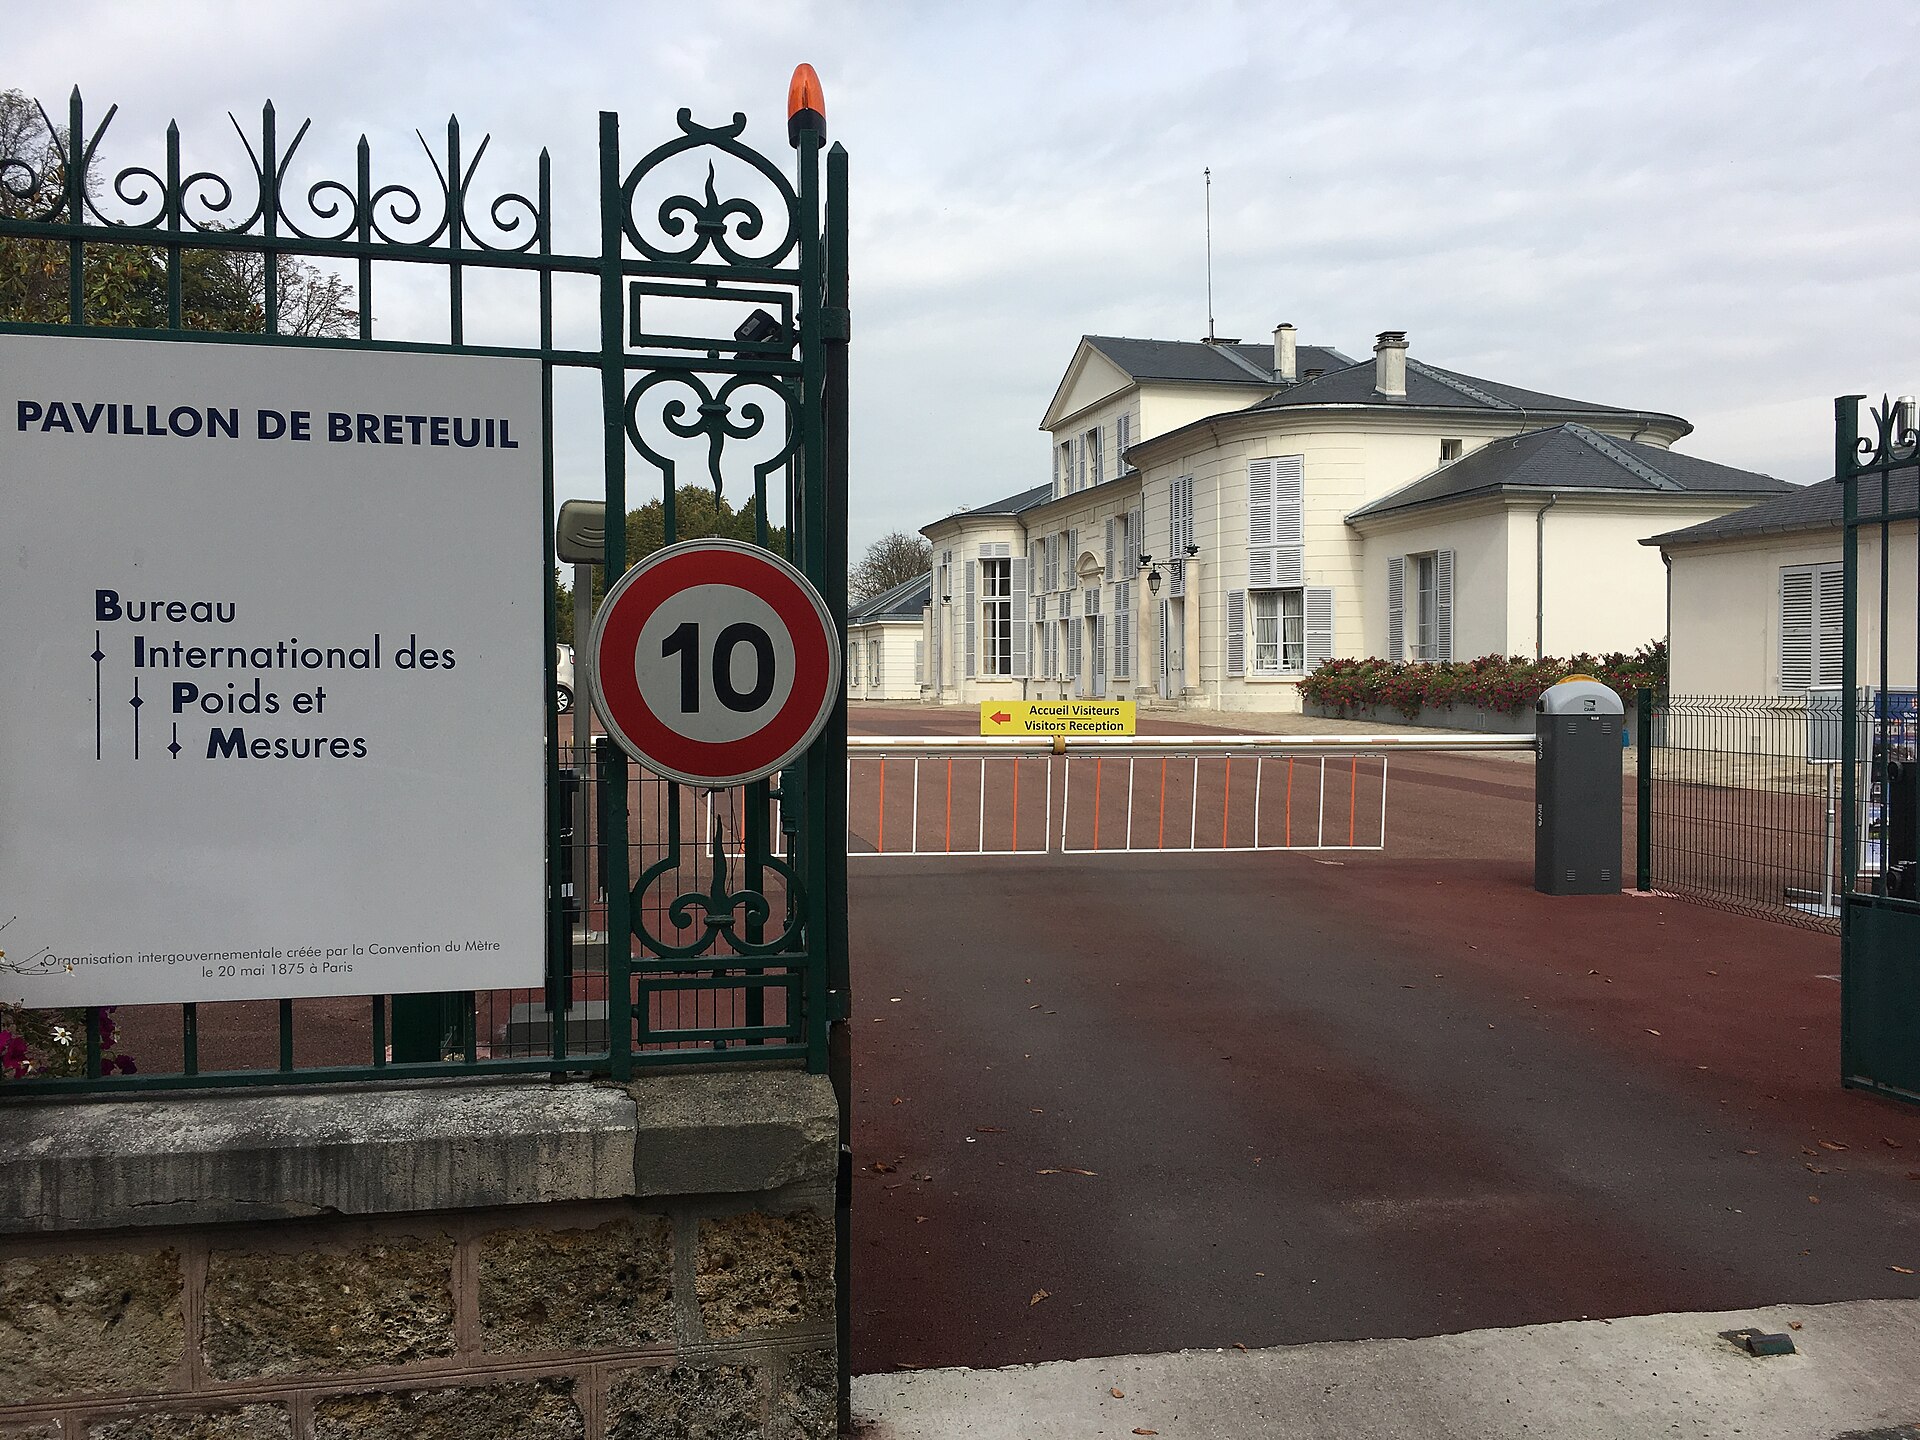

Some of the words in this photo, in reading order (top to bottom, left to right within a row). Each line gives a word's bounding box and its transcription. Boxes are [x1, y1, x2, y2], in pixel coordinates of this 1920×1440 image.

[17, 400, 239, 439] PAVILLON
[257, 409, 311, 442] DE
[327, 412, 519, 449] BRETEUIL
[95, 589, 236, 624] Bureau
[134, 633, 381, 670] International
[394, 633, 456, 670] des
[661, 621, 776, 714] 10
[172, 678, 280, 714] Poids
[292, 686, 327, 714] et
[1029, 705, 1069, 716] Accueil
[1072, 705, 1120, 716] Visiteurs
[205, 727, 368, 760] Mesures
[1024, 720, 1066, 731] Visitors
[1069, 720, 1124, 733] Reception
[43, 952, 133, 967] Organisation
[137, 947, 283, 964] intergouvernementale
[286, 947, 322, 958] créée
[326, 947, 349, 959] par
[352, 944, 364, 955] la
[368, 942, 441, 955] Convention
[444, 940, 461, 952] du
[464, 940, 501, 951] Mètre
[202, 965, 214, 978] le
[217, 965, 236, 977] 20
[240, 964, 265, 977] mai
[270, 963, 305, 976] 1875
[309, 963, 318, 974] à
[322, 961, 353, 973] Paris
